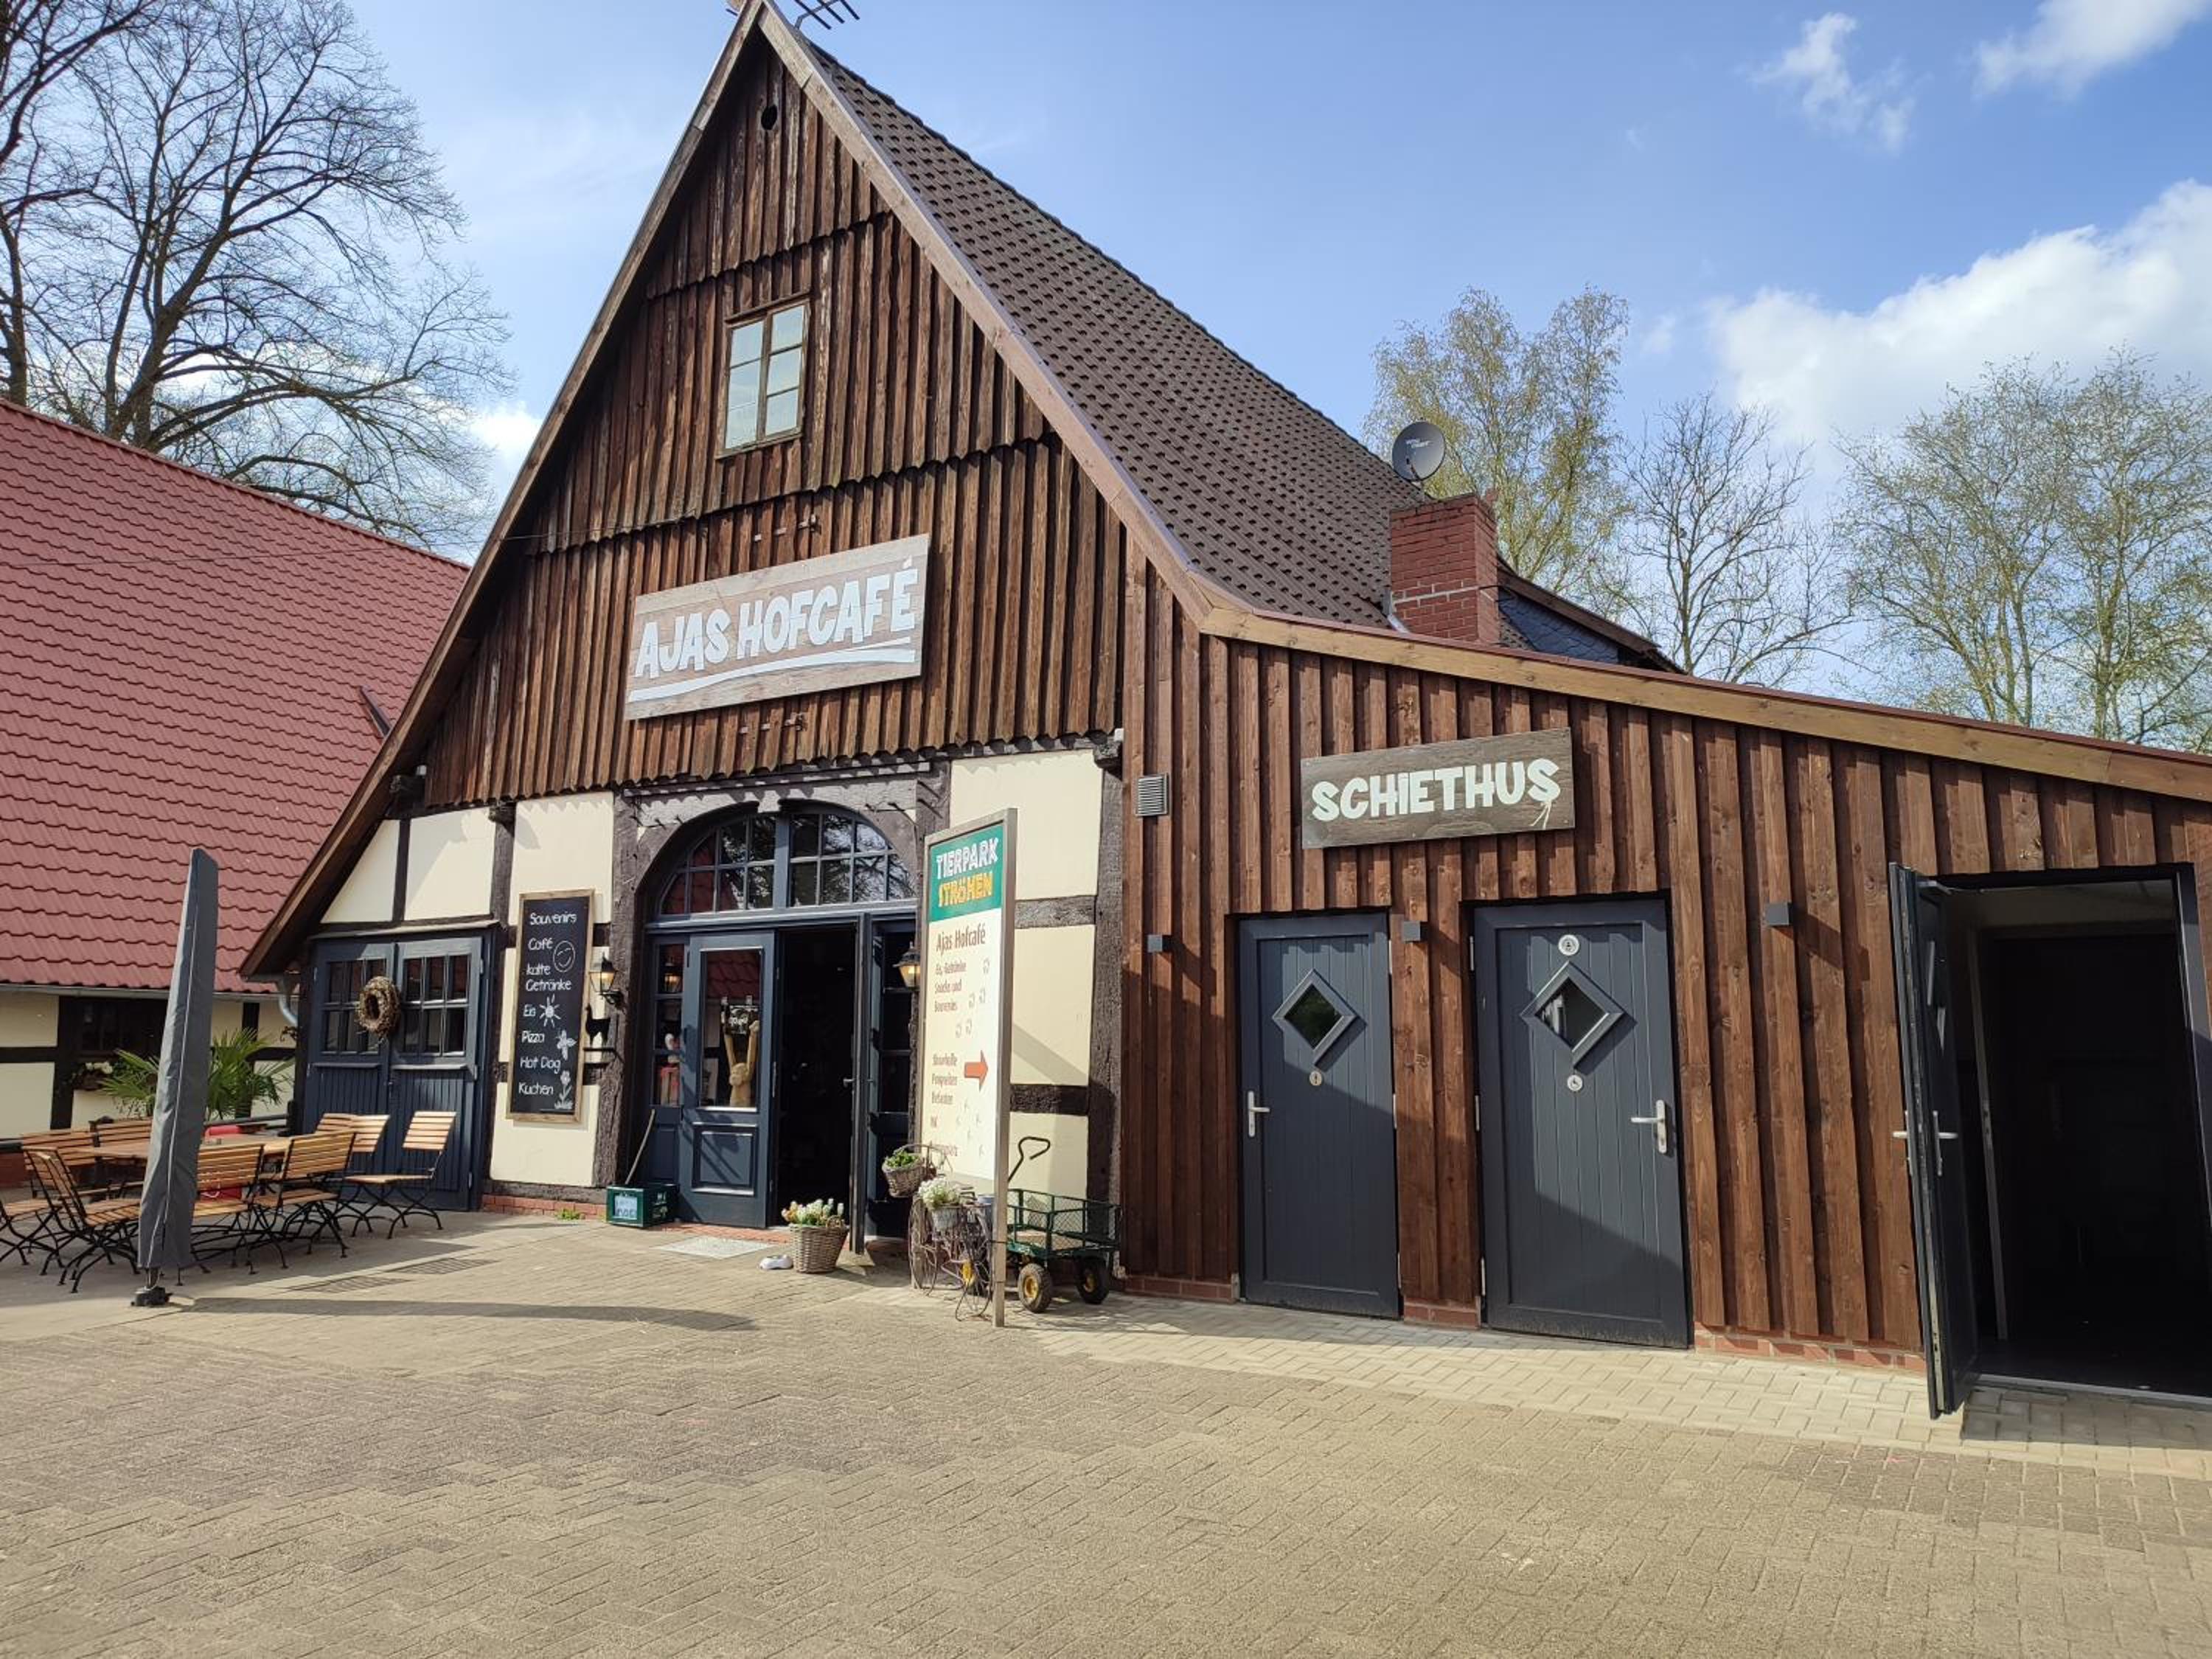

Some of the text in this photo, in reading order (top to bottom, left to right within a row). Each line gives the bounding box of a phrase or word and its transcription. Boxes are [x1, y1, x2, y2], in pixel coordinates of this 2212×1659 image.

[634, 554, 919, 679] AJAS HOFCAFÉ
[1311, 758, 1561, 822] SCHIETHUS
[936, 837, 999, 880] TIERPARK
[529, 911, 577, 925] Souvenirs
[528, 937, 553, 950] Café
[936, 922, 986, 956] Ajas Hofcafé
[526, 978, 571, 992] Getränke
[524, 1004, 536, 1017] Eis
[521, 1030, 545, 1043] Pizza
[520, 1056, 560, 1074] Hot Dog
[518, 1082, 554, 1095] Kuchen
